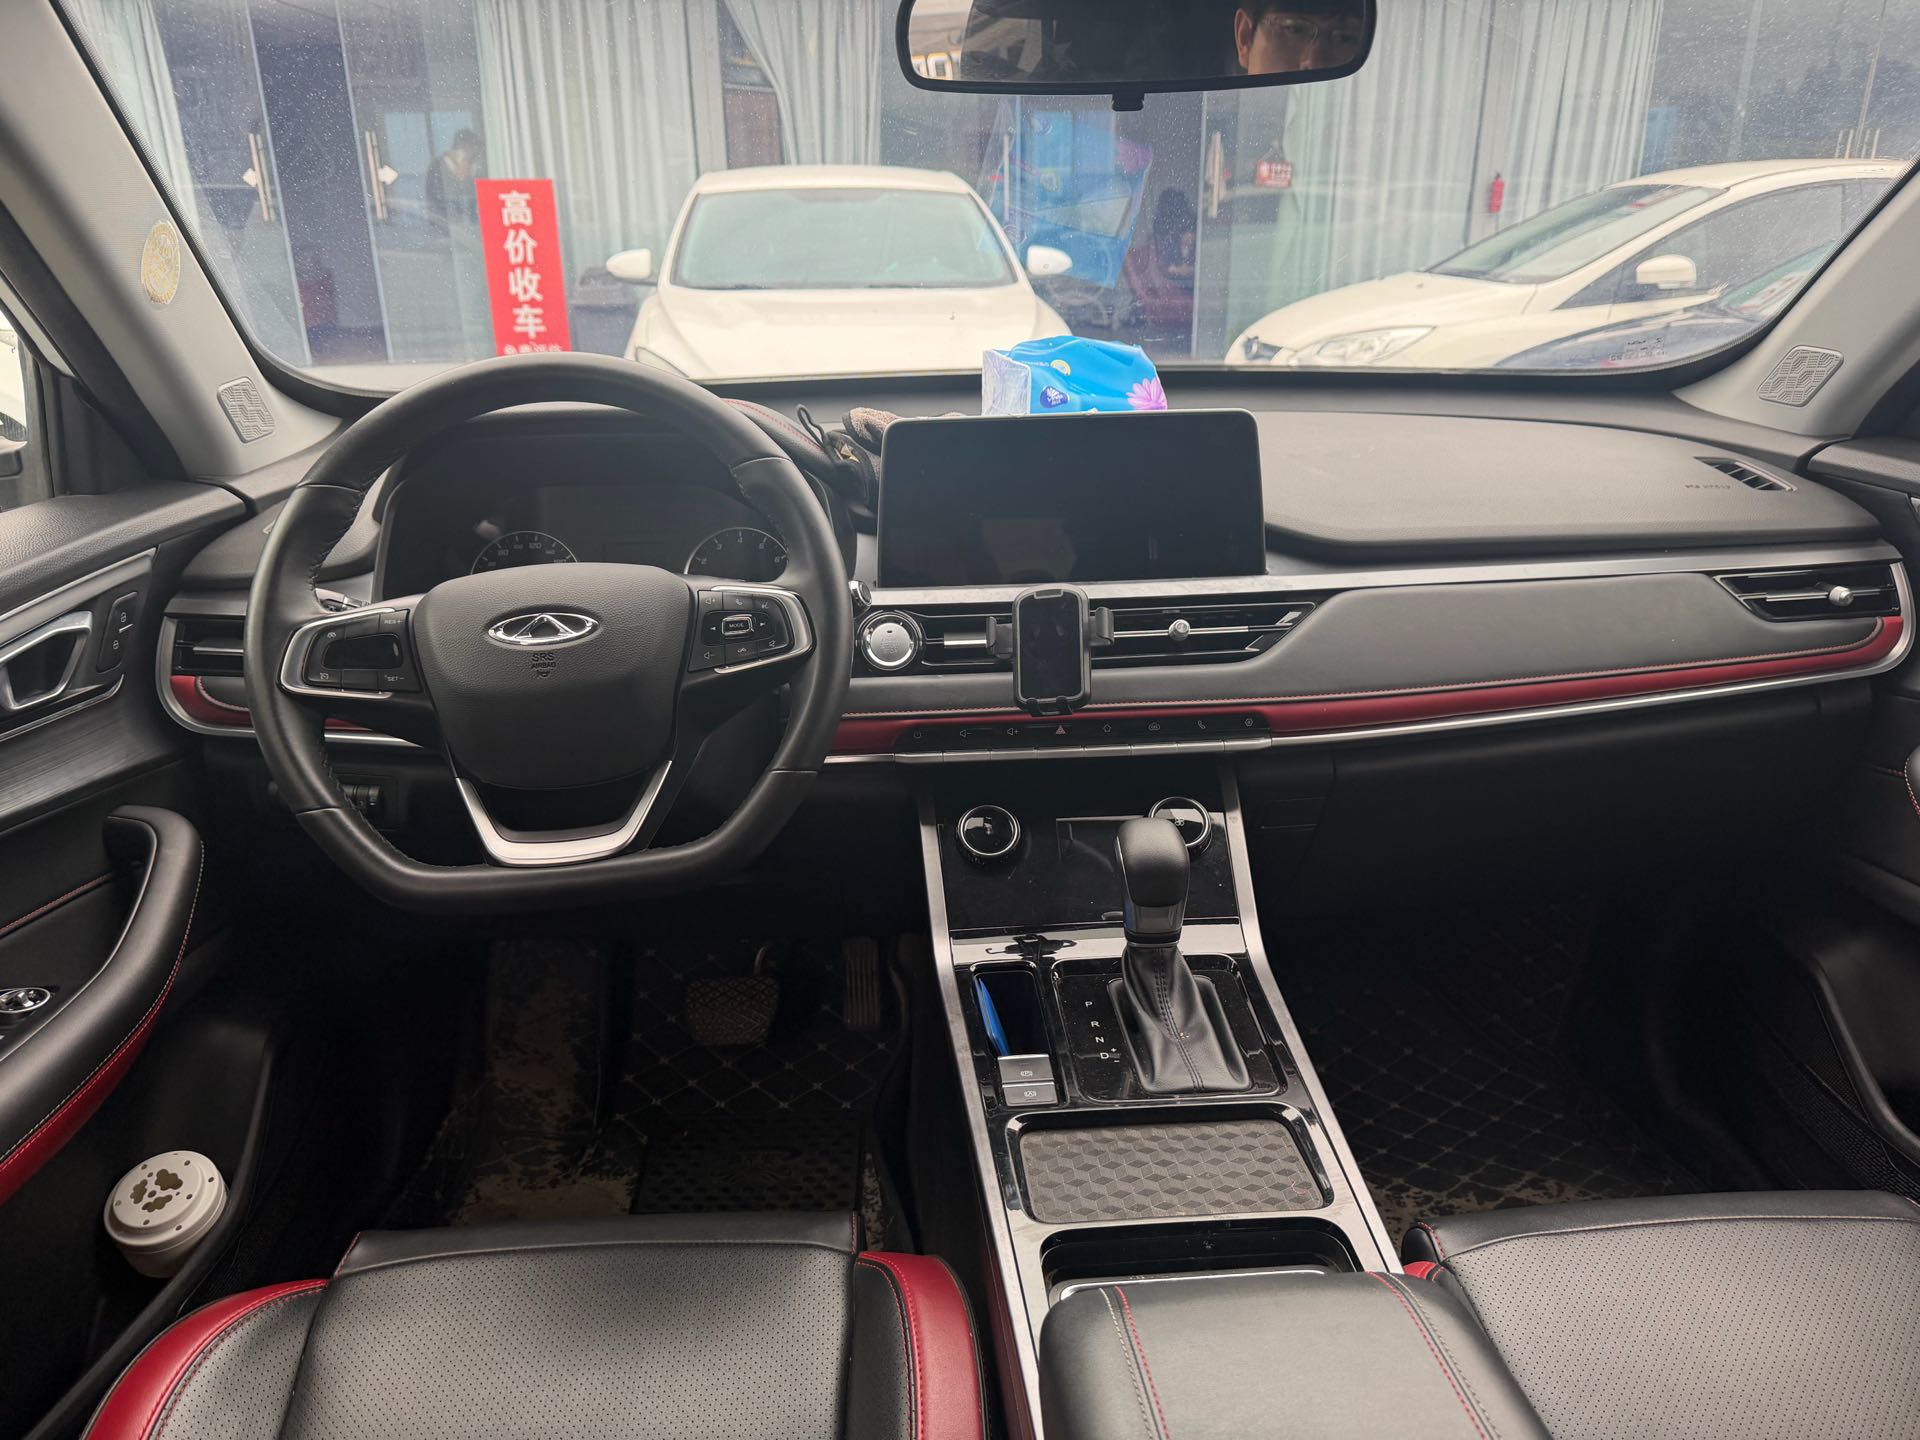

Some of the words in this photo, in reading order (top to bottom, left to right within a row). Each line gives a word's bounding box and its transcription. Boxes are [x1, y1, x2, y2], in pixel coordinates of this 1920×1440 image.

[498, 190, 546, 339] 高价收车
[531, 652, 555, 662] SRS
[1090, 1020, 1101, 1028] R
